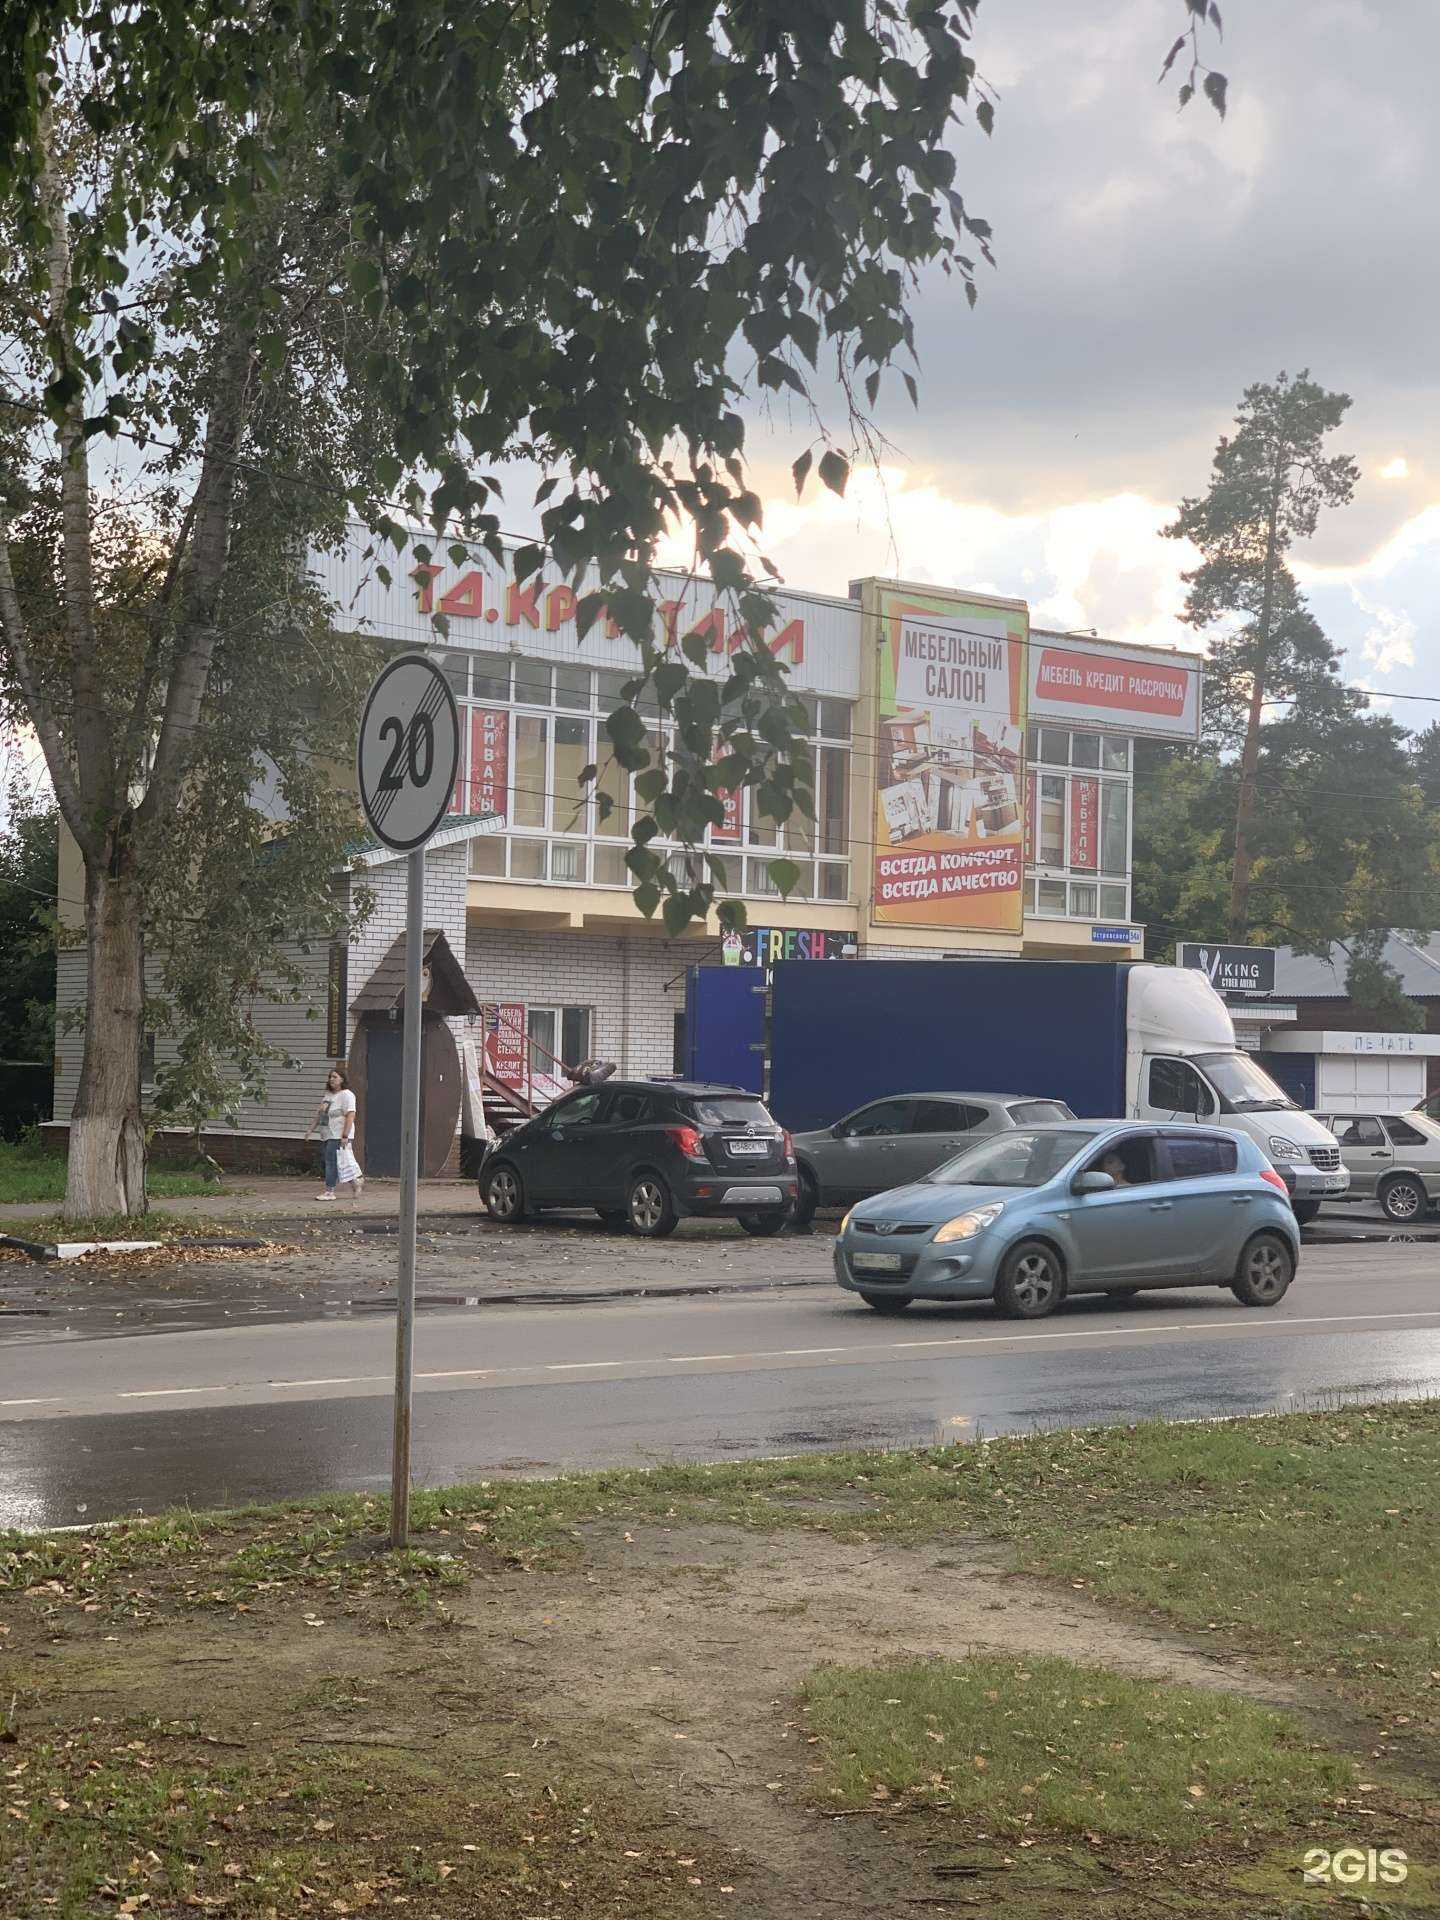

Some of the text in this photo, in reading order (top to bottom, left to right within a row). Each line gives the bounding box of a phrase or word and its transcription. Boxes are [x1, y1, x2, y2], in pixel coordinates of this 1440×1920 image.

[905, 630, 1002, 670] МЕБЕЛЬНЫЙ
[926, 664, 986, 703] САЛОН
[1041, 664, 1184, 700] МЕБЕЛЬ КРЕДИТ РАССРОЧКА
[378, 711, 434, 792] 20
[481, 715, 495, 812] ДИВАНЫ
[1079, 780, 1089, 862] МЕБЕЛЬ
[880, 856, 937, 876] ВСЕГДА
[882, 870, 1018, 899] ВСЕГДА КАЧЕСТВО
[756, 929, 825, 967] FRESH
[1199, 948, 1260, 986] VIKING
[1221, 978, 1257, 989] CYBER ARENA
